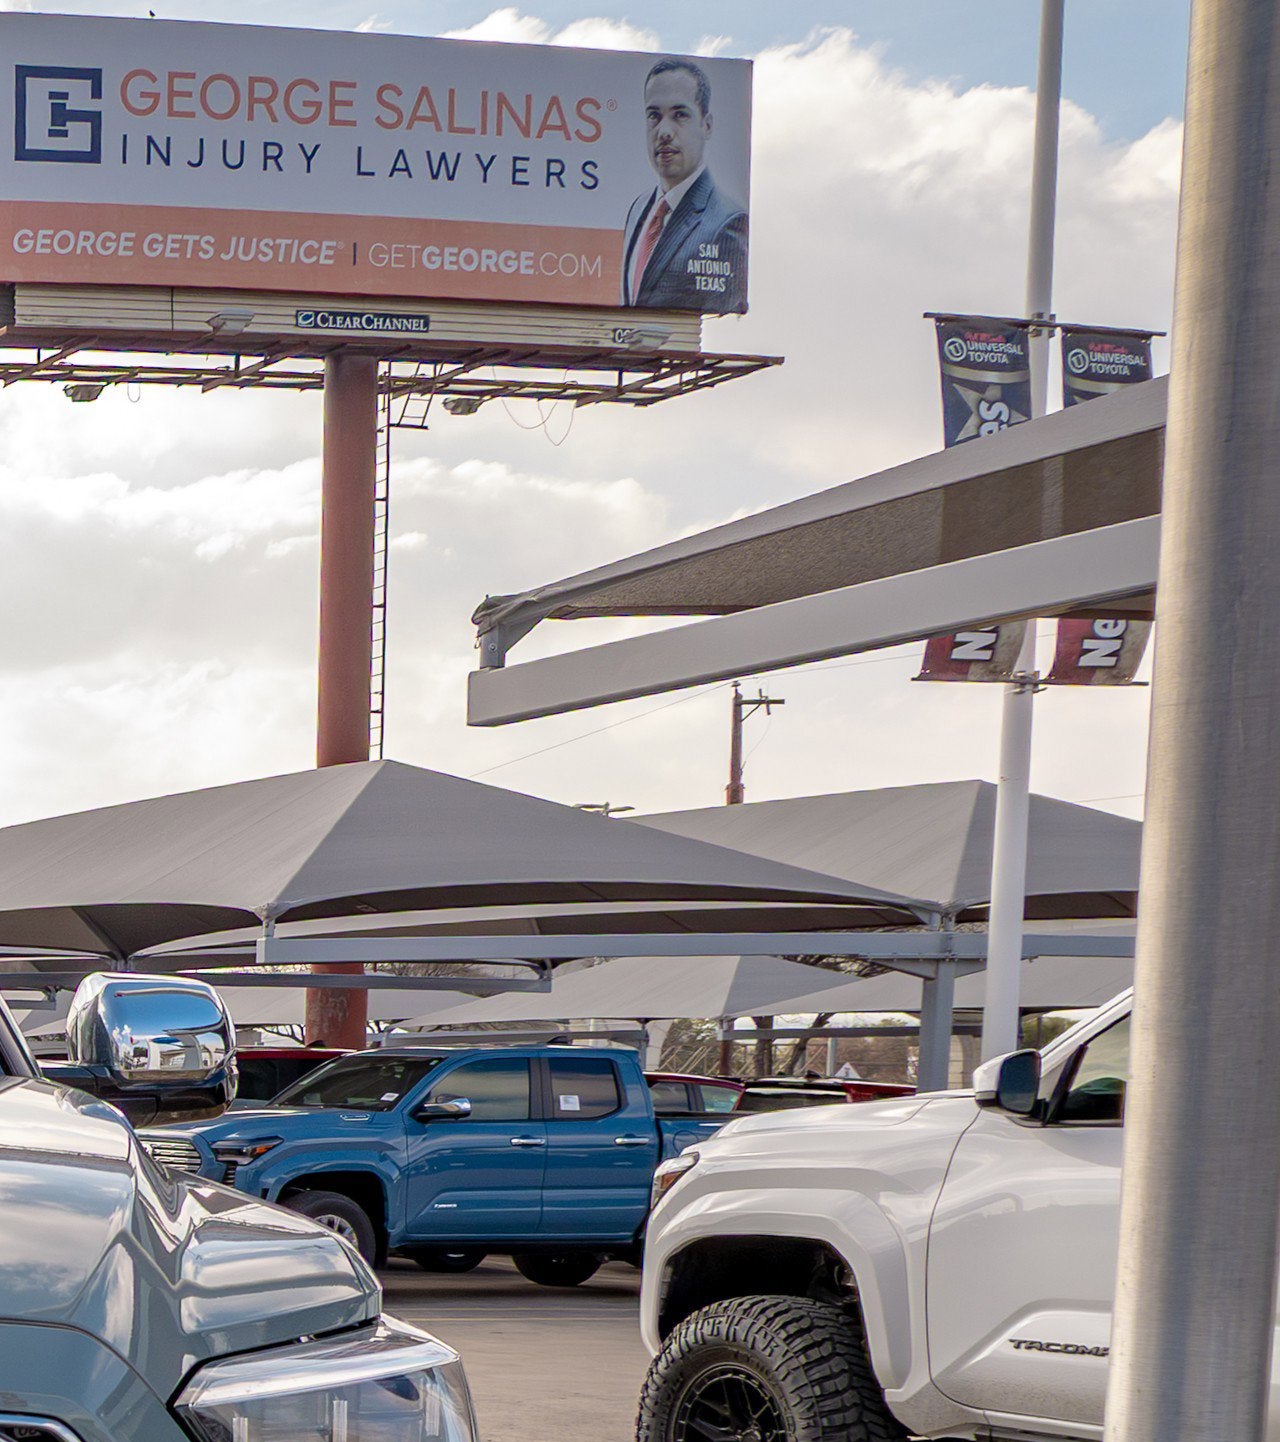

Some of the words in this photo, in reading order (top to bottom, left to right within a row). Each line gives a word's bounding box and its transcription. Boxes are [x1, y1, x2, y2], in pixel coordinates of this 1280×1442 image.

[120, 68, 357, 127] GEORGE
[121, 134, 321, 174] INJURY
[356, 145, 600, 190] LAWYERS
[12, 229, 136, 257] GEORGE
[142, 233, 215, 260] GETS
[369, 243, 602, 278] GETGEORGE.COM
[699, 243, 719, 259] SAN
[695, 275, 726, 292] TEXAS
[966, 340, 1024, 355] UNIVERSAL
[968, 351, 1009, 364] TOYOTA
[1090, 351, 1146, 366] UNIVERSAL
[1090, 362, 1130, 376] TOYOTA
[1078, 619, 1127, 667] Ne
